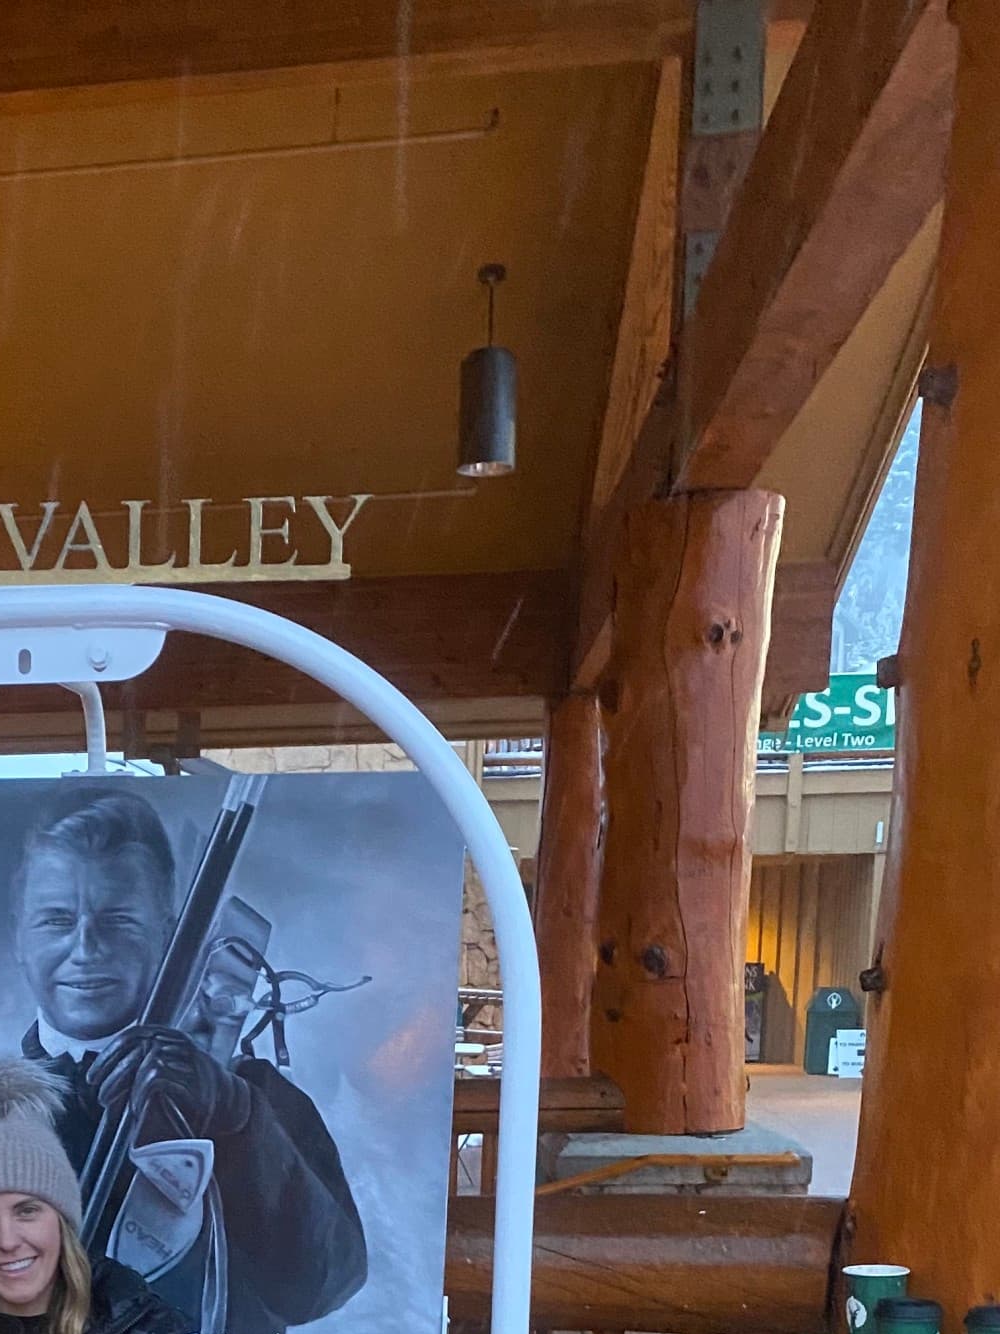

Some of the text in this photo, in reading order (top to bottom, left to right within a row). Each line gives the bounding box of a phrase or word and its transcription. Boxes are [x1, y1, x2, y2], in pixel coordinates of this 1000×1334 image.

[797, 733, 837, 748] Level
[842, 733, 876, 747] Two
[125, 1220, 173, 1260] HEAD
